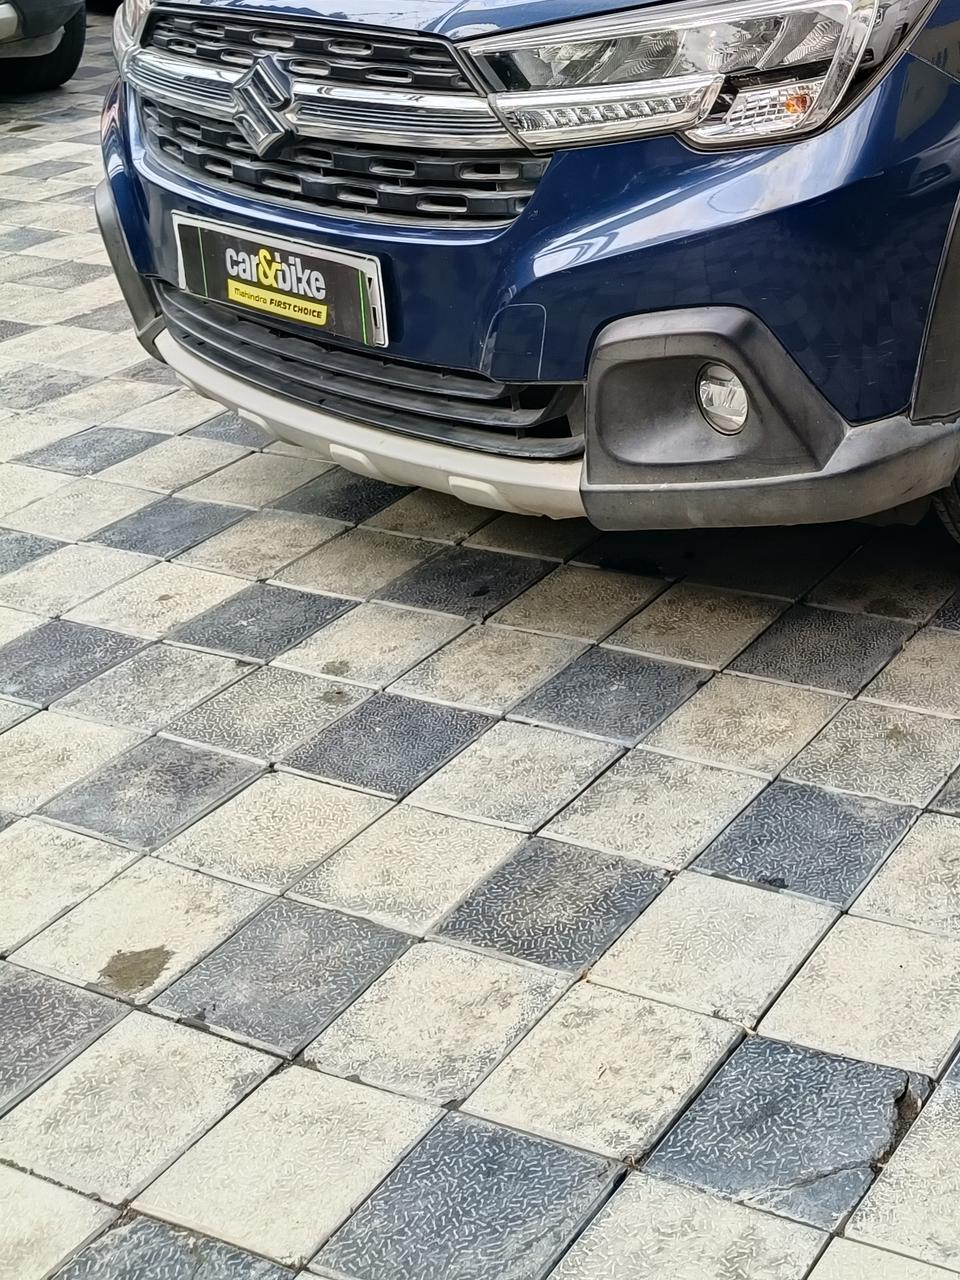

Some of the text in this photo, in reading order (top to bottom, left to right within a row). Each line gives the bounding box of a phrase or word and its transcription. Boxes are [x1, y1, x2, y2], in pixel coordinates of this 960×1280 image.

[225, 248, 327, 300] car&bike
[234, 287, 322, 319] Mahindra FIRST CHOICE
